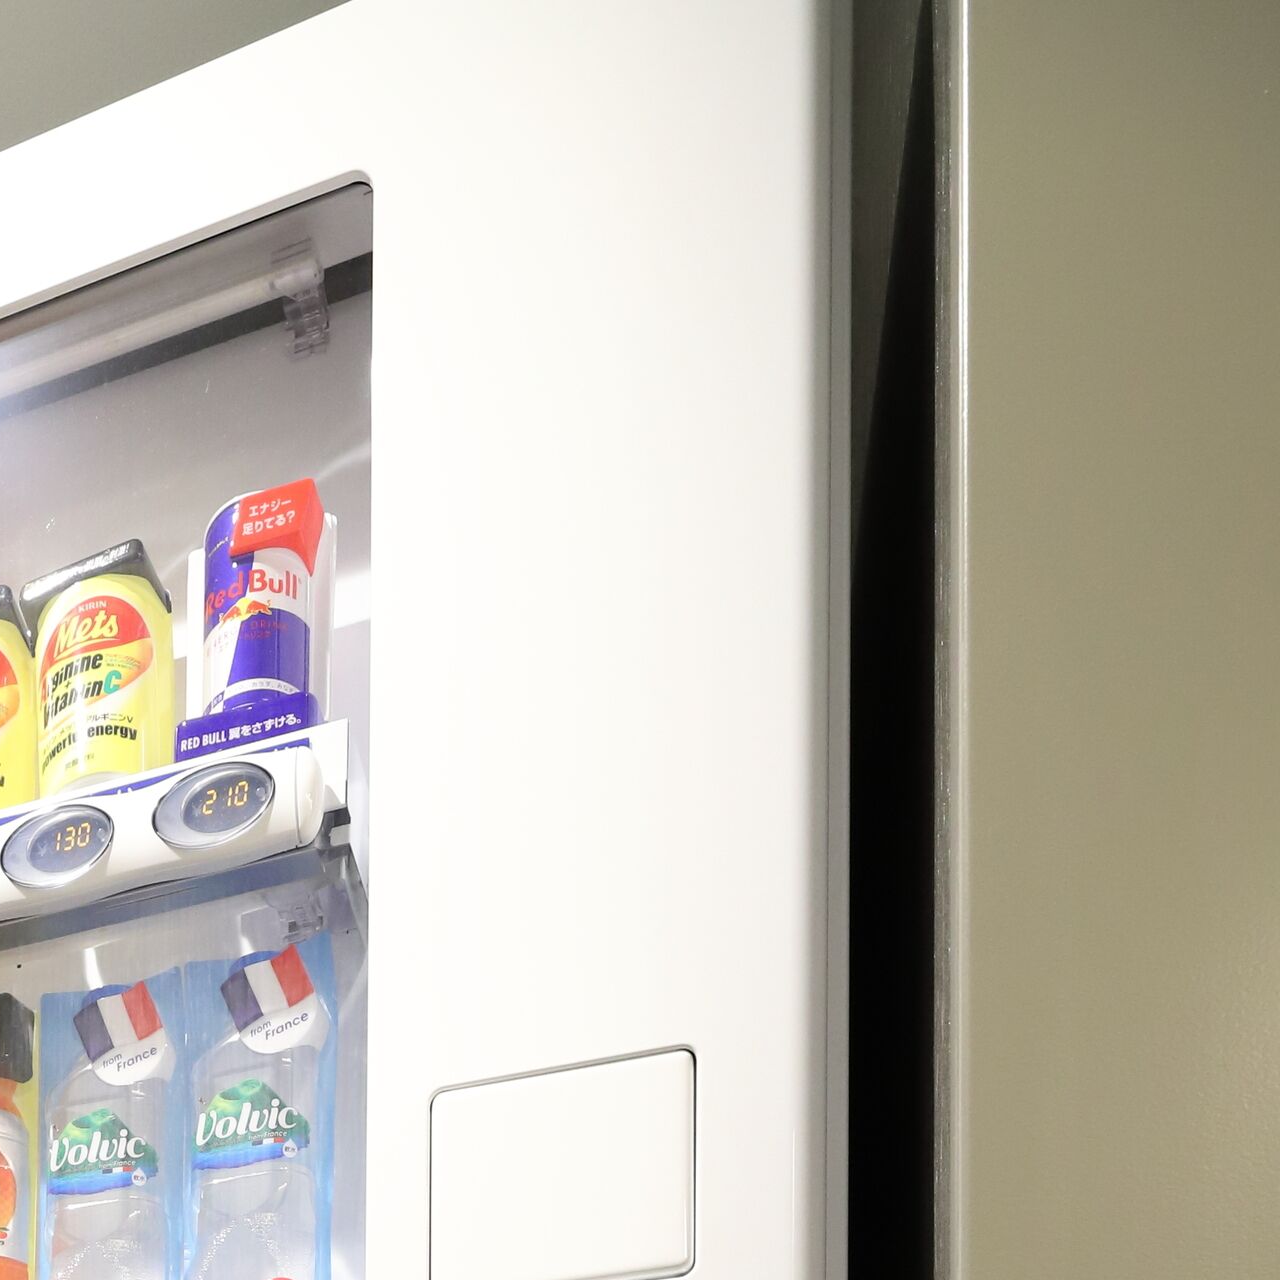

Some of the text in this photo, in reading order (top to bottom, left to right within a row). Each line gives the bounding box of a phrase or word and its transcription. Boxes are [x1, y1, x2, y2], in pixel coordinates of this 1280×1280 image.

[242, 509, 297, 536] 足りてる?
[248, 498, 292, 519] エナジー
[249, 567, 299, 601] Bull
[53, 610, 121, 658] Mets
[86, 724, 138, 741] energy
[180, 713, 302, 752] RED BULL 翼をさずける。
[202, 782, 249, 816] 210
[55, 822, 92, 852] 130
[250, 1020, 272, 1038] from
[265, 1012, 309, 1041] France
[102, 1053, 122, 1069] from
[116, 1046, 157, 1072] France
[195, 1098, 299, 1147] Volvic
[50, 1129, 146, 1173] Volvic
